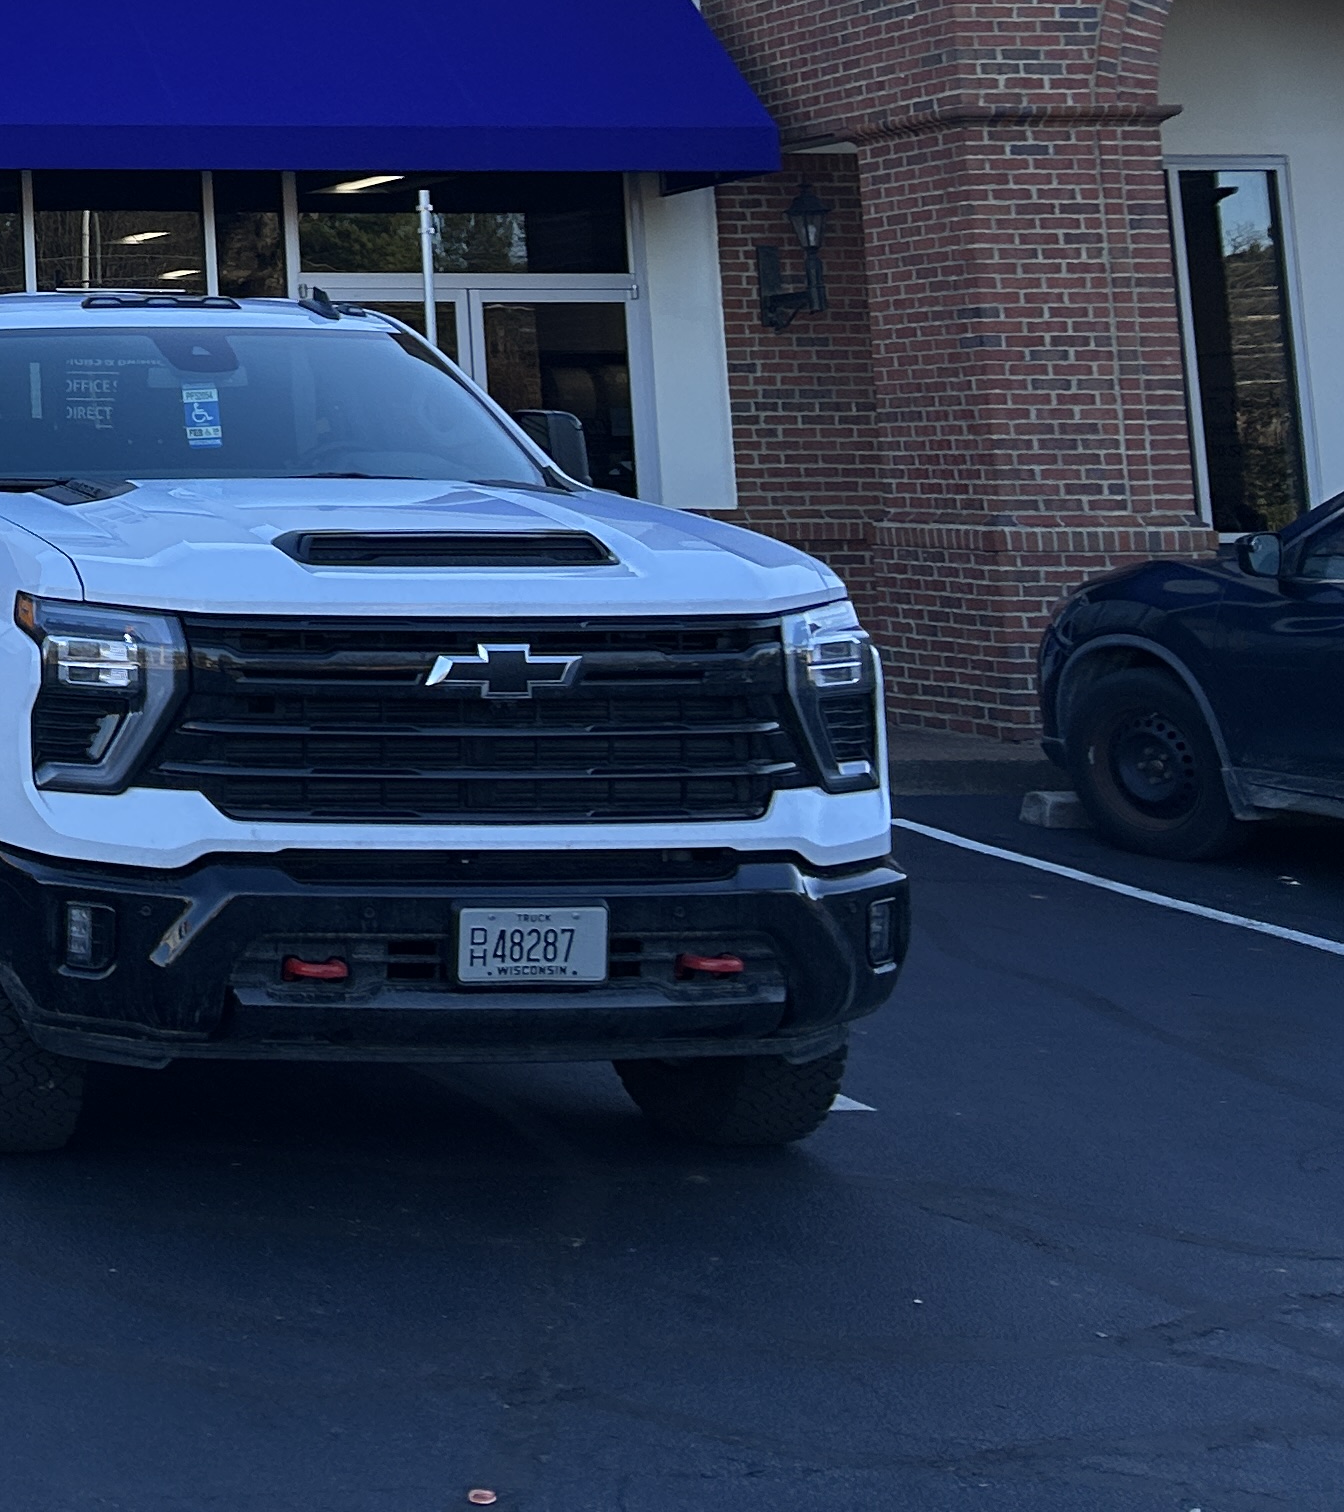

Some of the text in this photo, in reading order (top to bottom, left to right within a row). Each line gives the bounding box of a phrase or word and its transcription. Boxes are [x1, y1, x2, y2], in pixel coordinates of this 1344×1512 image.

[516, 913, 552, 923] TRUCK
[492, 928, 575, 963] 48287
[496, 965, 568, 976] WISCONSIN
